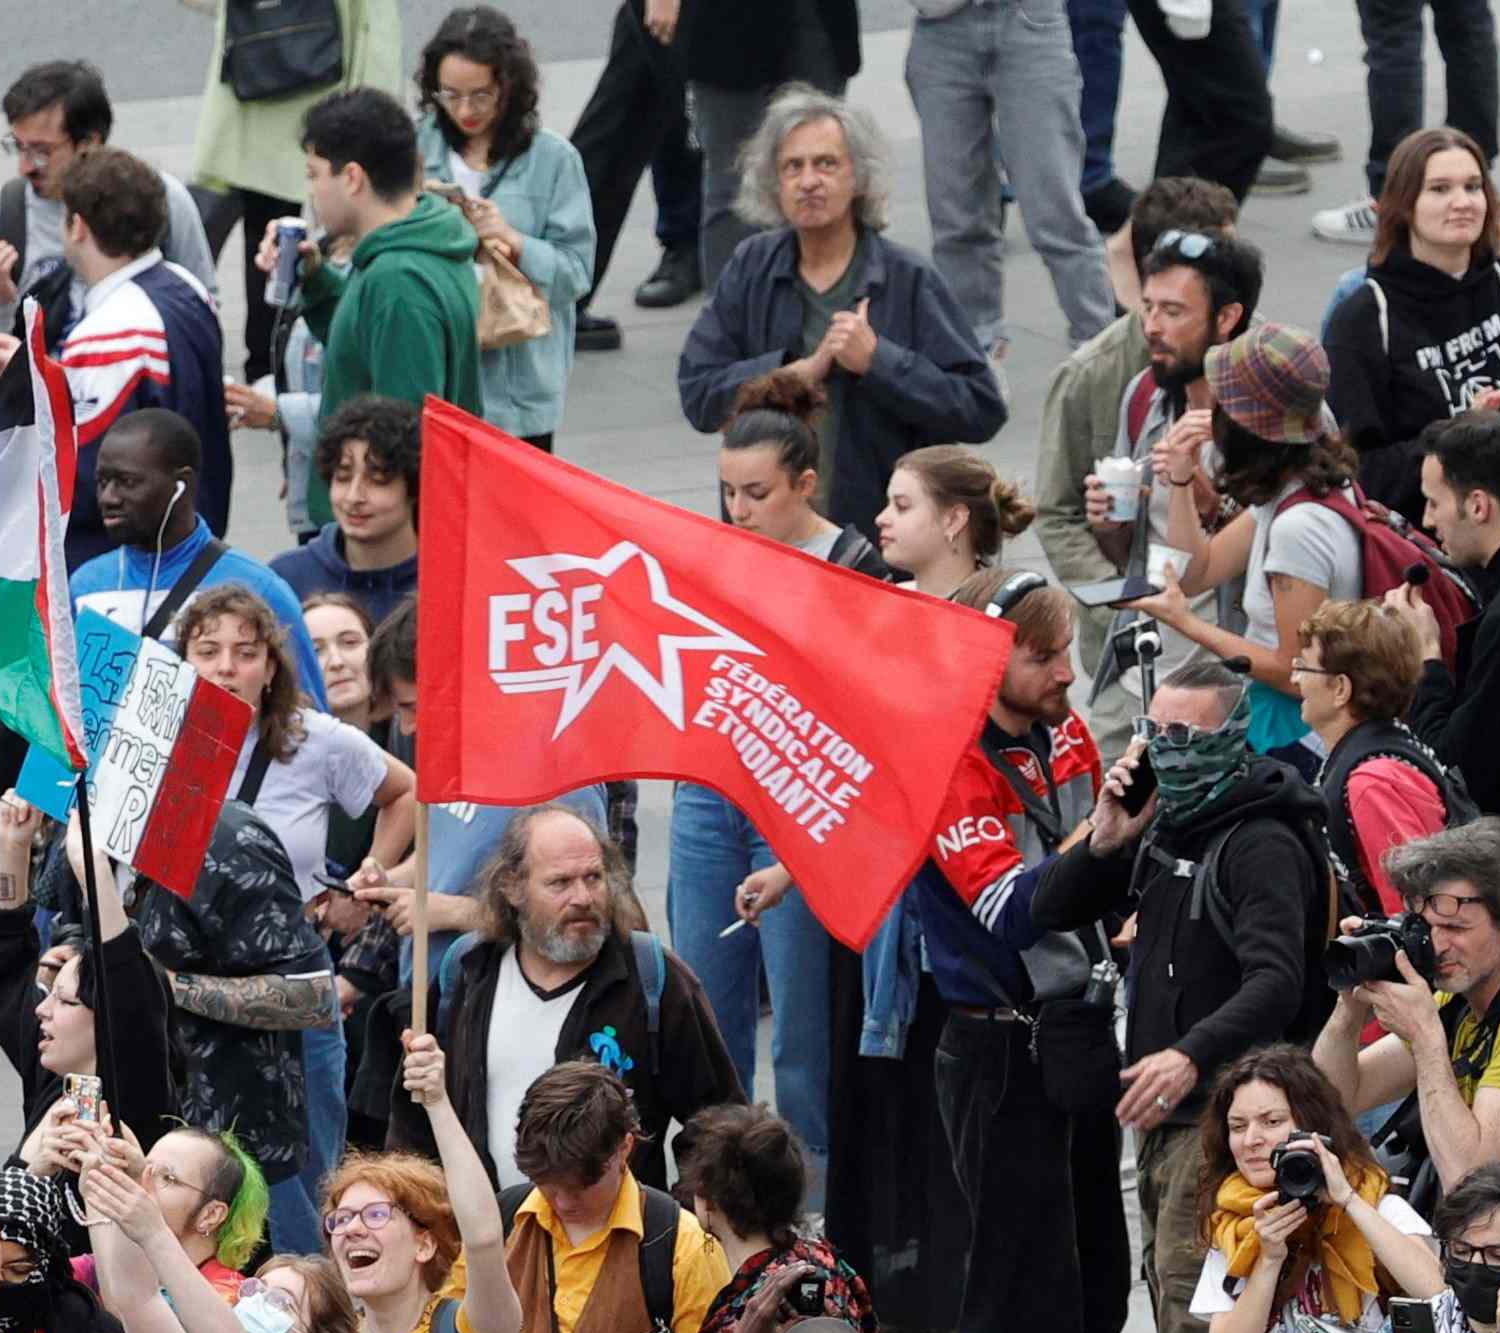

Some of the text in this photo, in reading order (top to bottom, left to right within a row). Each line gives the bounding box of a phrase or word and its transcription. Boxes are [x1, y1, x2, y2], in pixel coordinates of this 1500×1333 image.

[489, 583, 604, 671] FSE
[692, 699, 846, 844] ÉTUDIANTE
[704, 676, 861, 809] SYNDICALE
[710, 654, 875, 784] FÉDÉRATION
[936, 815, 1006, 861] NEO
